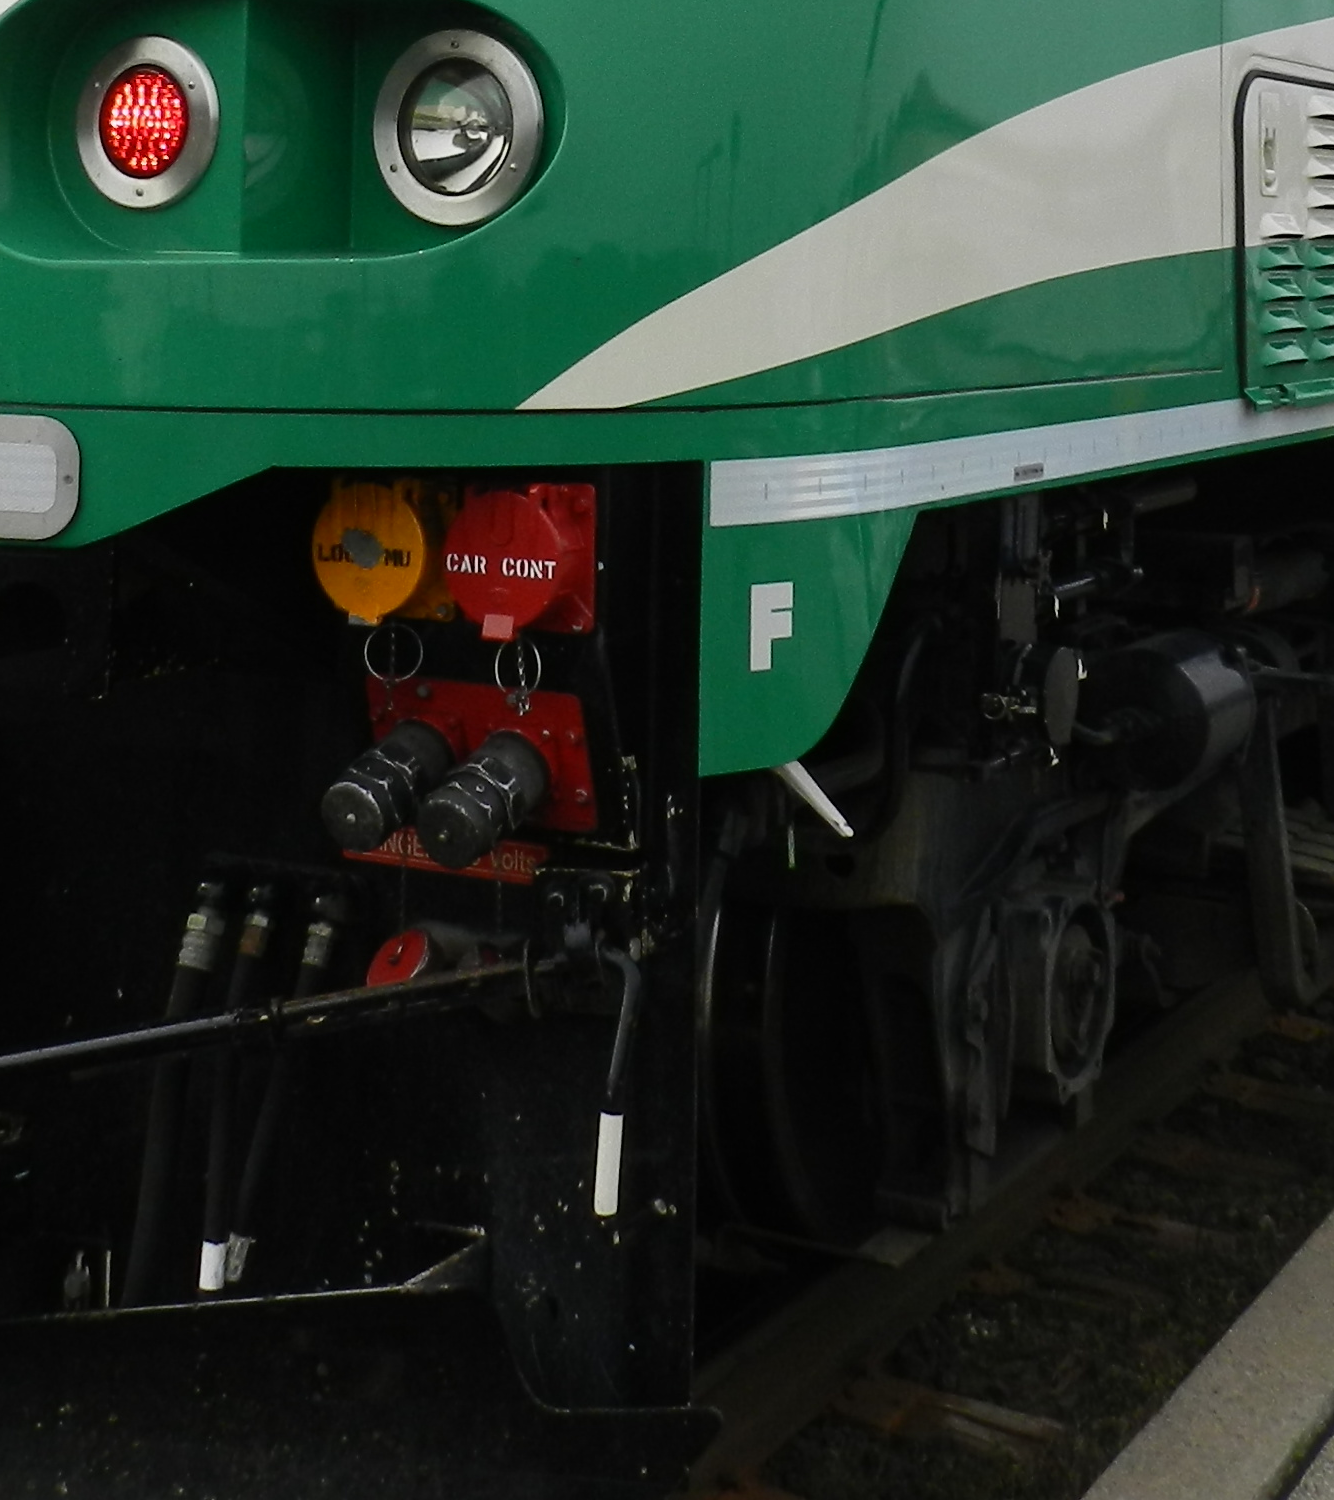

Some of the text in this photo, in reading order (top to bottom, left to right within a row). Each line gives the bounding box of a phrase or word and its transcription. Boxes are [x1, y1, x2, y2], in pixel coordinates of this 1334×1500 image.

[445, 553, 558, 582] CAR CONT
[749, 581, 794, 673] F
